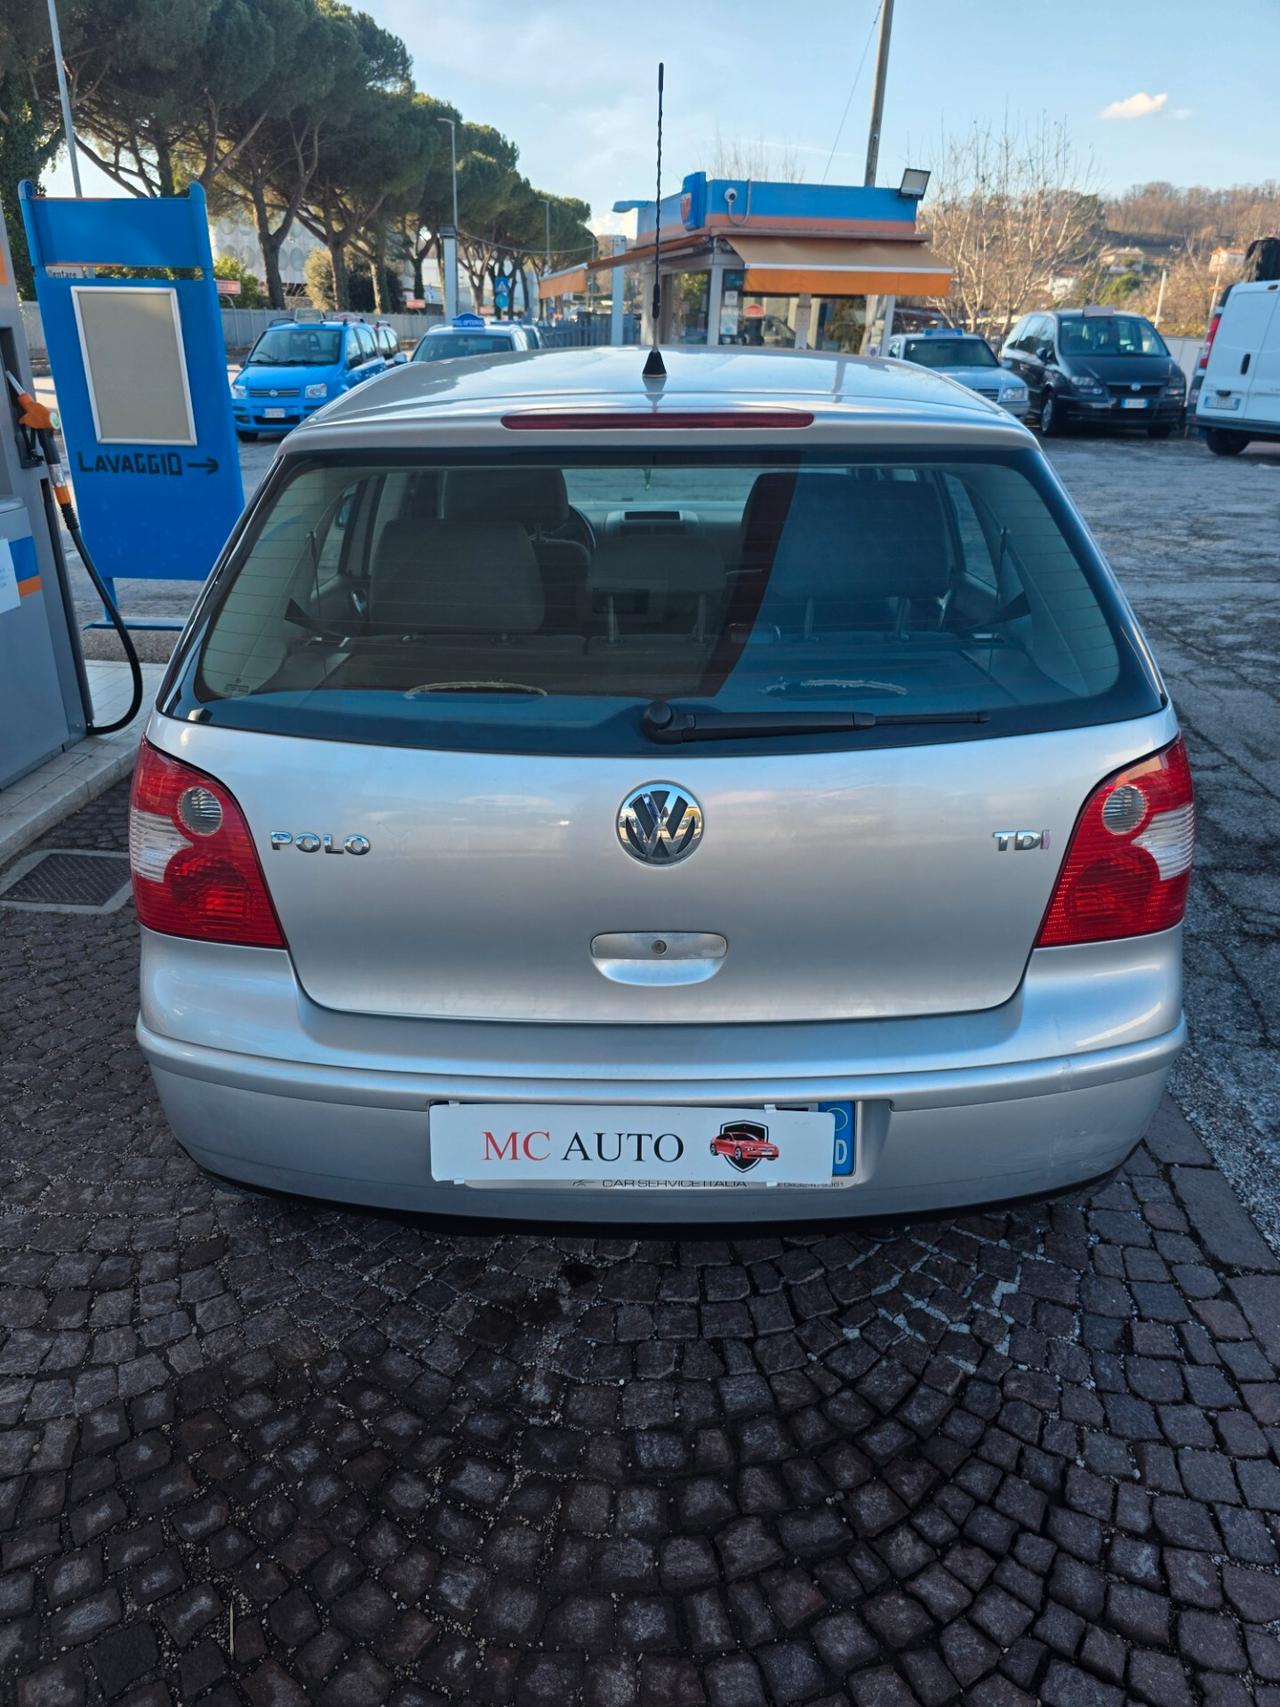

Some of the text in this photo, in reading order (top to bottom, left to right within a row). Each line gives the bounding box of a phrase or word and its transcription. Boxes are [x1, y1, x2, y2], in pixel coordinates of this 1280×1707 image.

[77, 451, 183, 476] LAVAGGIO
[618, 782, 703, 864] VW
[270, 830, 371, 856] POLO
[992, 828, 1050, 852] TDI
[482, 1131, 685, 1163] MC AUTO
[602, 1179, 635, 1188] CAR
[703, 1179, 748, 1188] ITALIA
